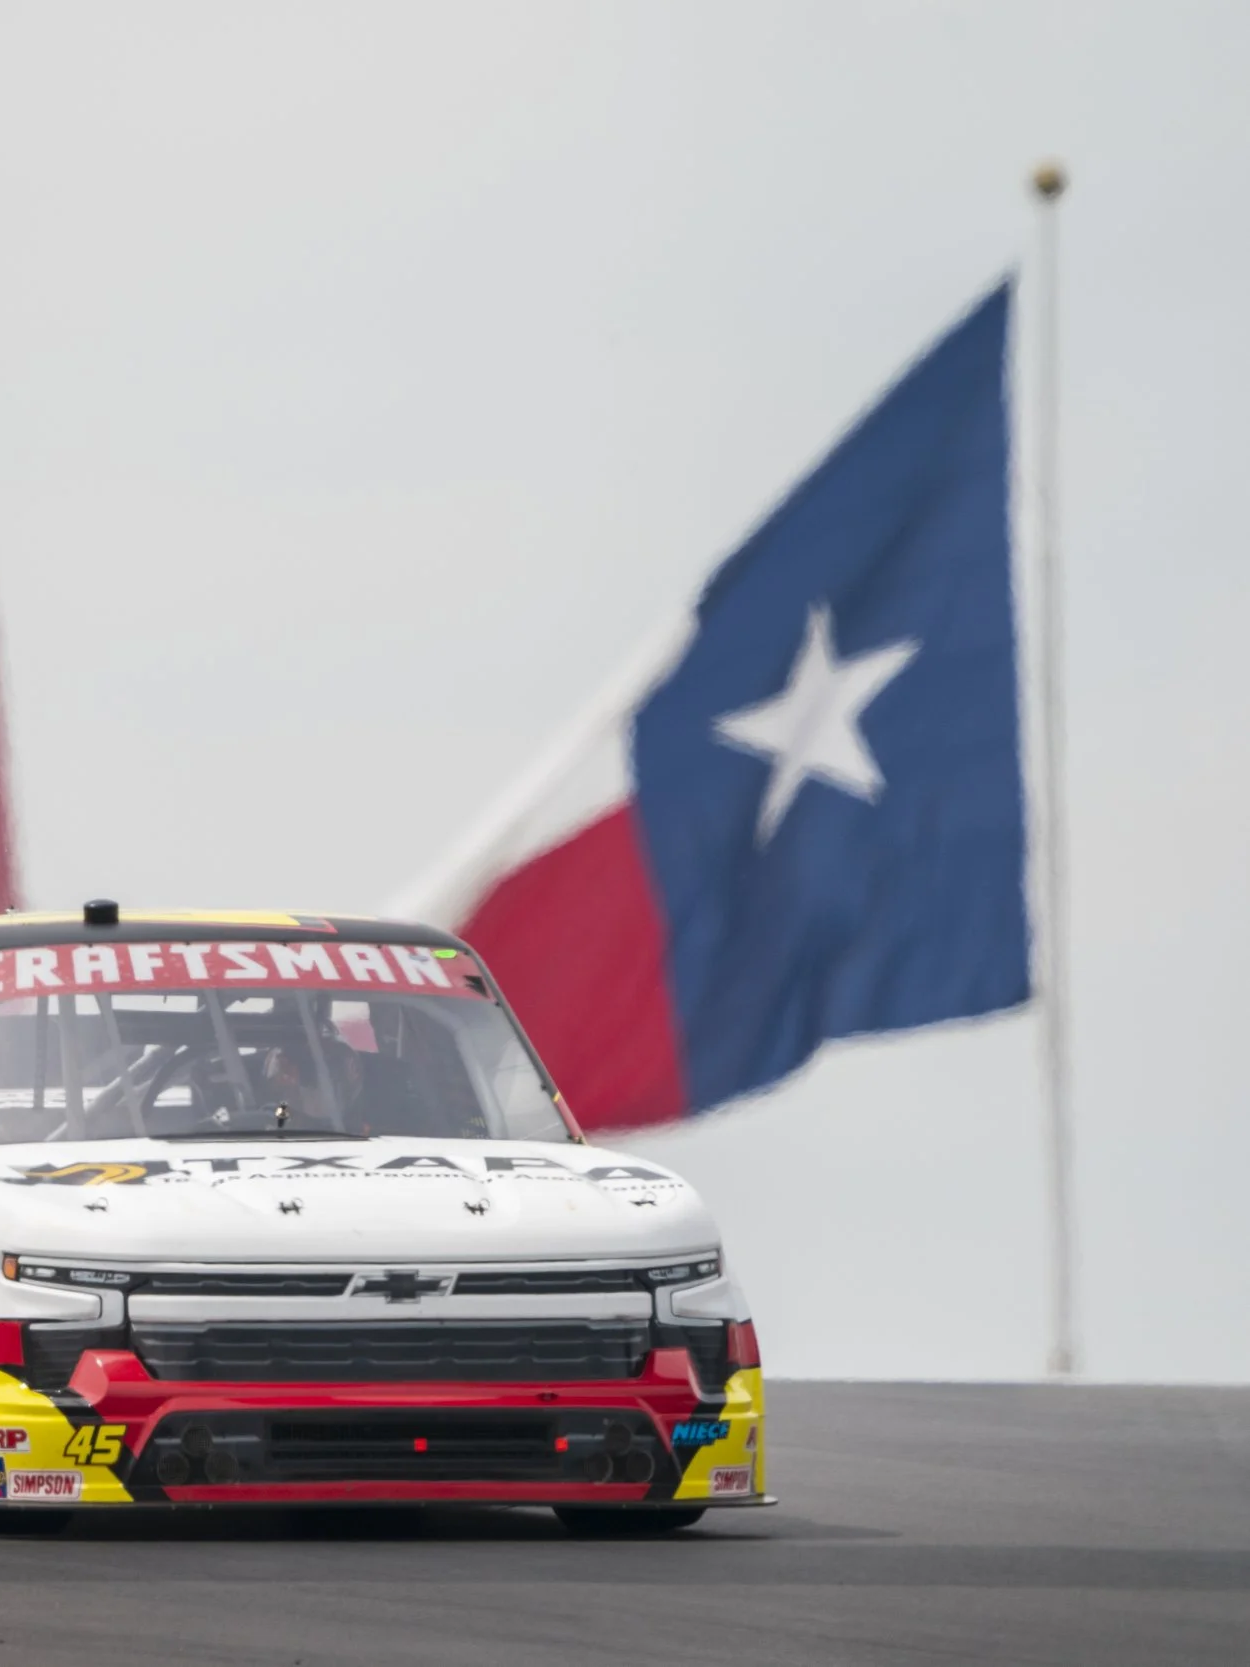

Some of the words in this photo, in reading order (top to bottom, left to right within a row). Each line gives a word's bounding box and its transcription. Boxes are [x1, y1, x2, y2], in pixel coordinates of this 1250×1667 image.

[182, 1154, 672, 1181] TXAPA
[64, 1424, 127, 1465] 45
[13, 1473, 76, 1495] SIMPSON
